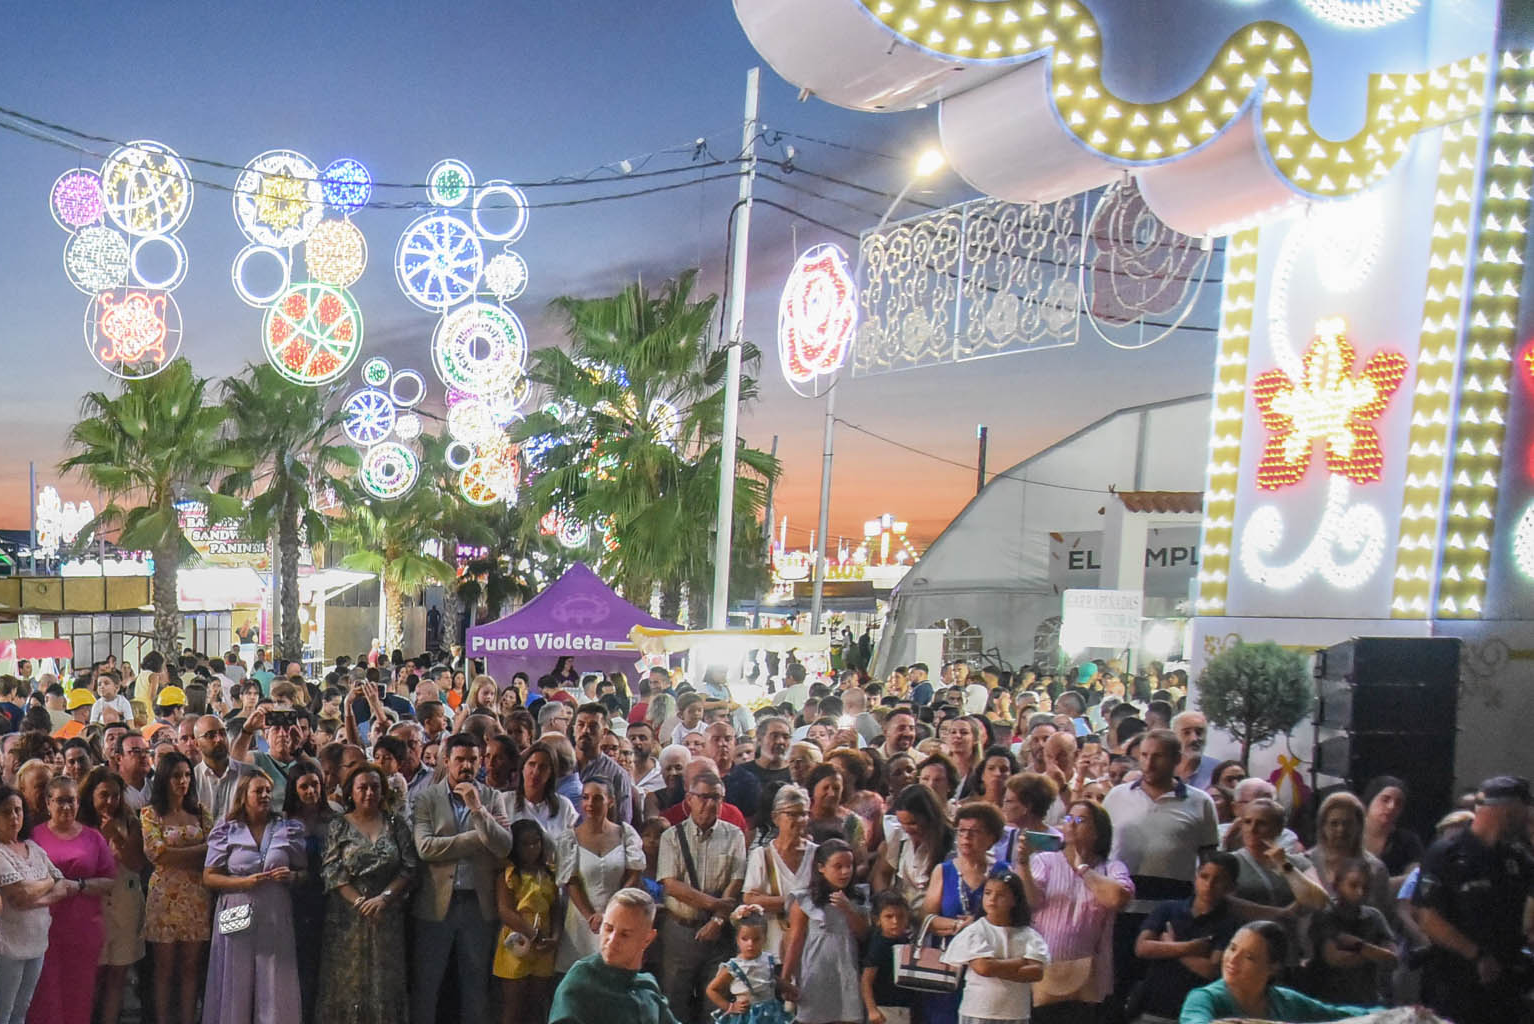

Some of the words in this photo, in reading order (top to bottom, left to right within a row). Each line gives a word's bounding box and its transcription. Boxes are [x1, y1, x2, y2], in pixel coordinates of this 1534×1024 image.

[1068, 550, 1101, 570] EL
[472, 634, 529, 651] Punto
[533, 633, 603, 651] Violeta
